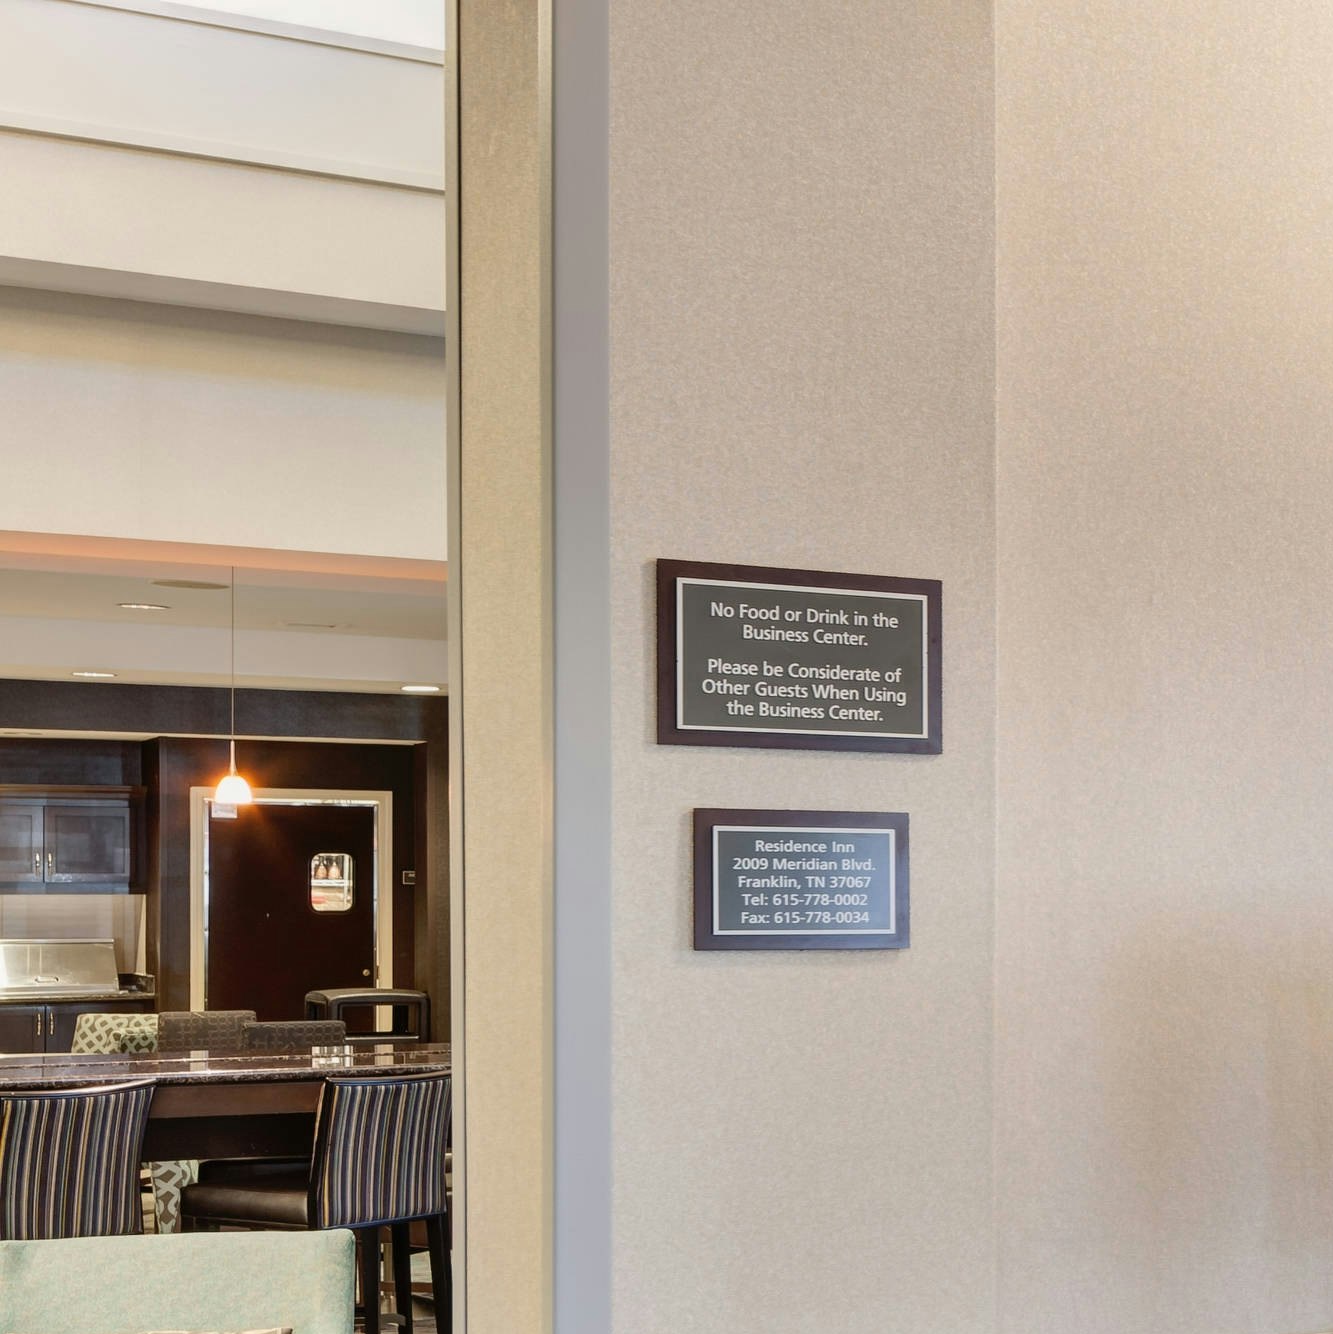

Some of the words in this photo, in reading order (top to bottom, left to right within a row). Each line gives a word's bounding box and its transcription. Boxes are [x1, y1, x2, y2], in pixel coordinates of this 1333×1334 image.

[711, 602, 734, 617] No
[739, 604, 780, 621] Food
[785, 608, 802, 622] or
[807, 608, 849, 625] Drink
[854, 611, 868, 626] in
[872, 613, 899, 628] the
[743, 625, 809, 643] Business
[813, 629, 868, 646] Center.
[708, 658, 758, 676] Please
[763, 661, 783, 677] be
[788, 663, 881, 682] Considerate
[885, 668, 902, 683] of
[702, 679, 750, 695] Other
[755, 682, 808, 698] Guests
[812, 684, 859, 700] When
[864, 687, 907, 706] Using
[726, 700, 754, 716] the
[759, 703, 825, 719] Business
[829, 705, 884, 721] Center.
[755, 840, 827, 853] Residence
[832, 841, 855, 853] Inn
[732, 858, 769, 870] 2009
[773, 858, 837, 871] Meridian
[842, 859, 876, 871] Blvd.
[738, 876, 801, 889] Franklin,
[805, 876, 825, 888] TN
[829, 876, 872, 888] 37067
[741, 894, 769, 906] Tel:
[772, 894, 868, 906] 615-778-0002
[741, 911, 770, 924] Fax:
[774, 911, 870, 924] 615-778-0034
